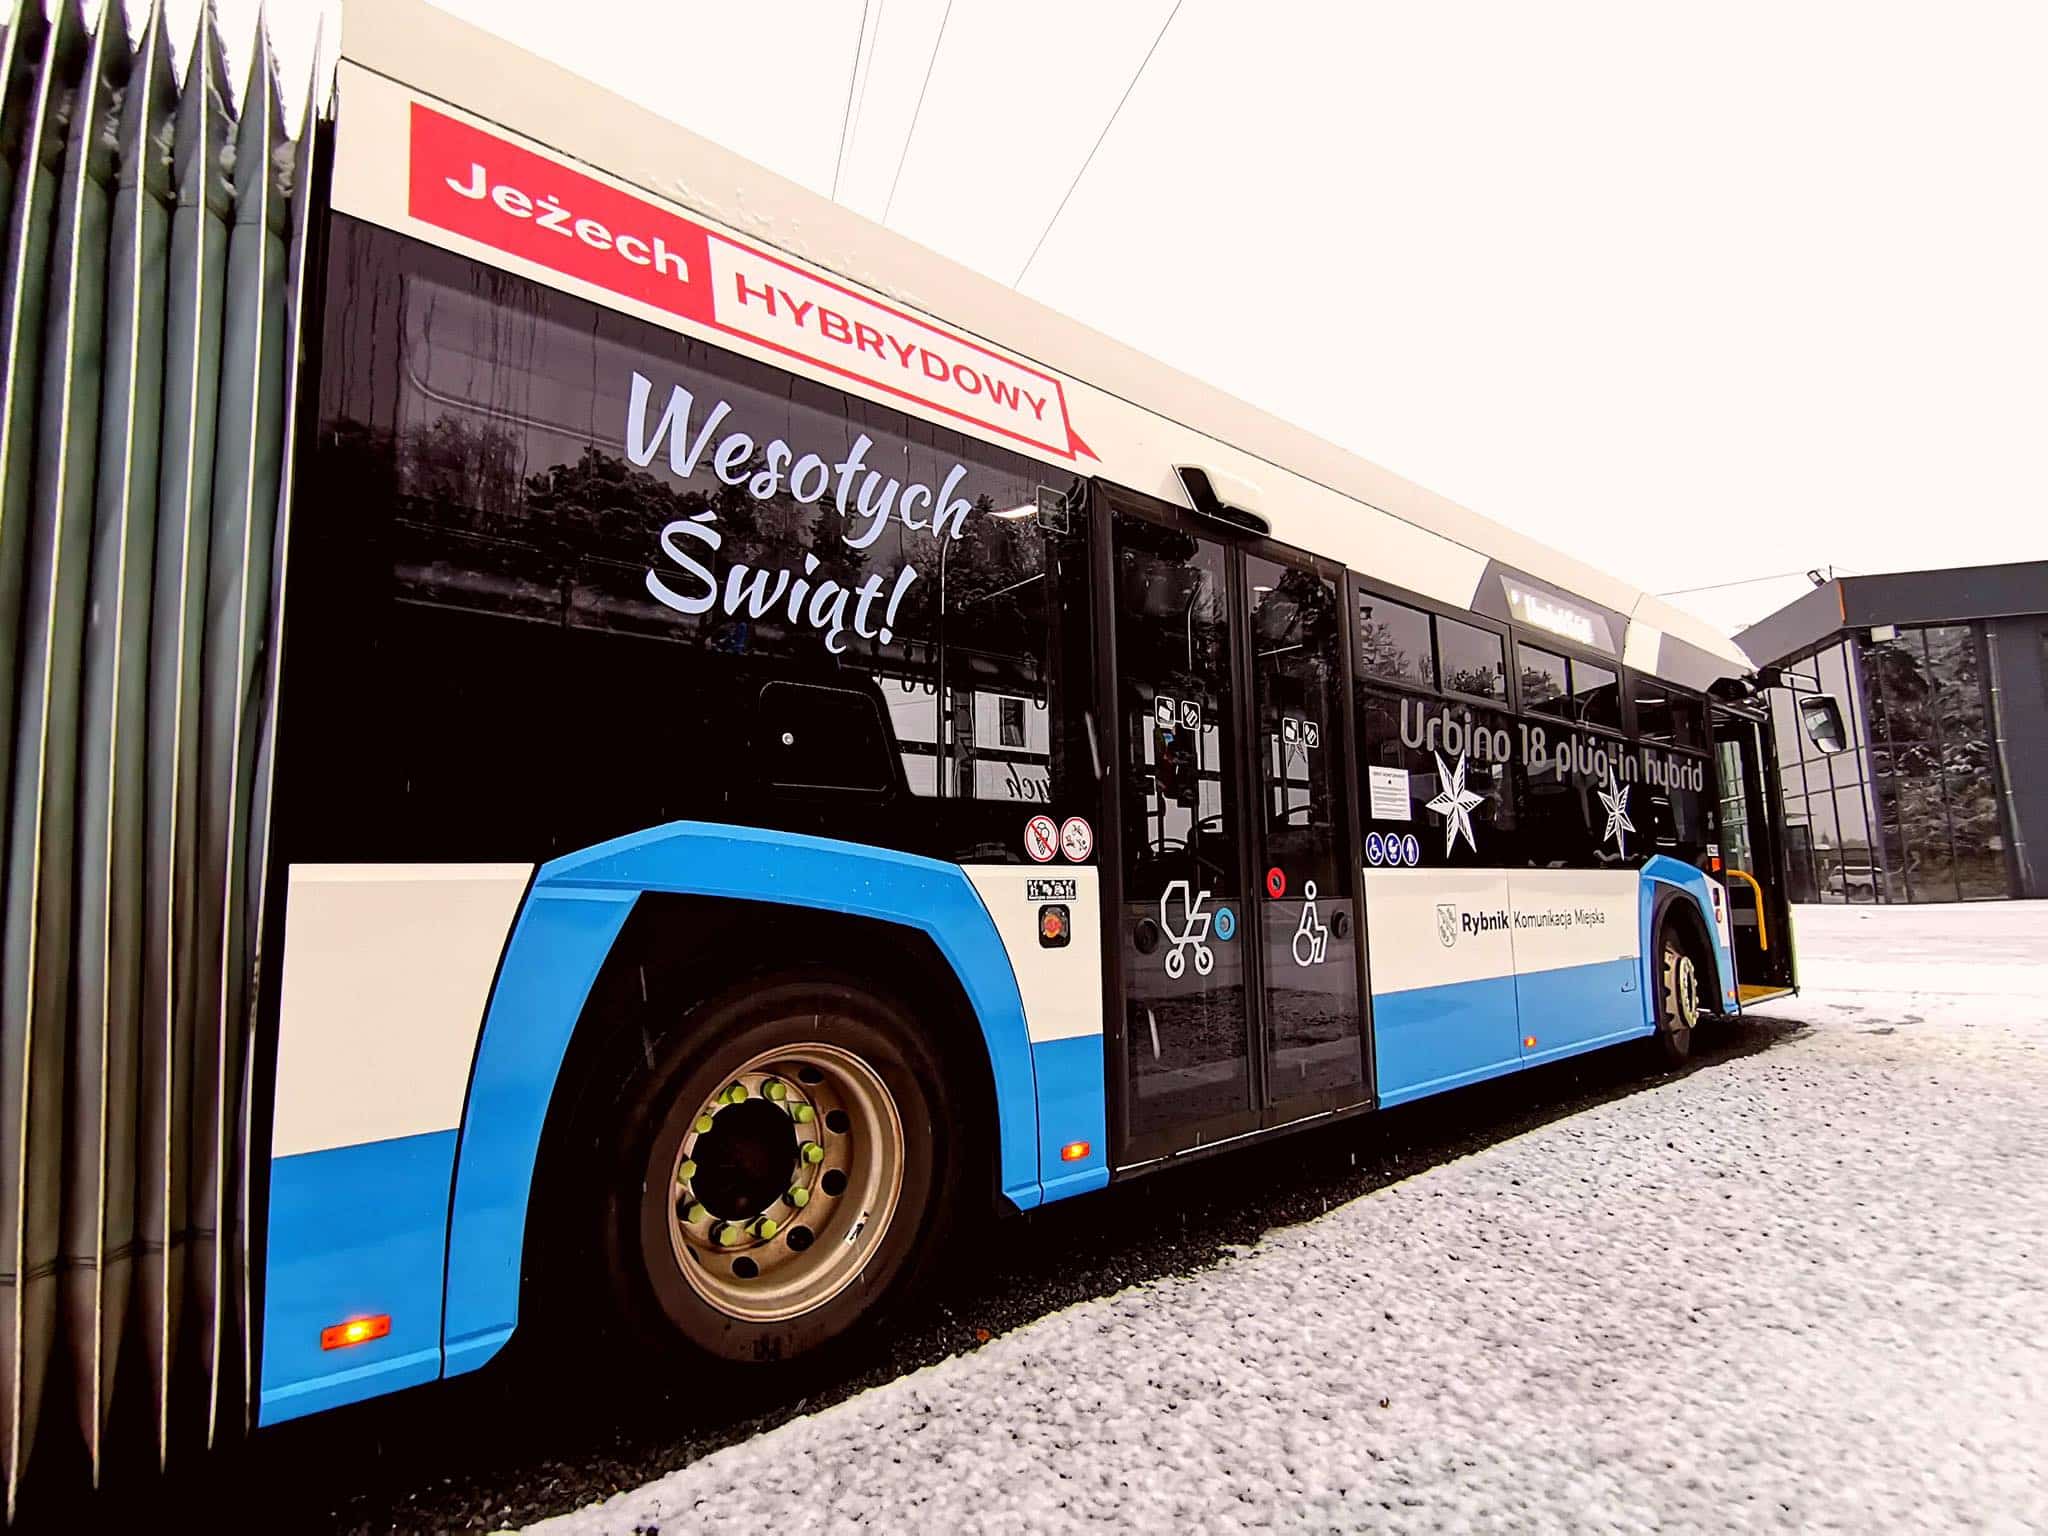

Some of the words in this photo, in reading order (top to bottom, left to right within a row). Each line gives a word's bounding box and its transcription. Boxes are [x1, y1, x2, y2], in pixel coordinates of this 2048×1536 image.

[445, 163, 690, 283] Jeżech
[735, 272, 1047, 421] HYBRYDOWY
[626, 371, 973, 550] Wesołych
[645, 510, 918, 654] Świąt!
[1400, 698, 1512, 763] Urbino
[1517, 722, 1547, 769] 18
[1645, 747, 1703, 796] hybrid
[1461, 910, 1510, 937] Rybnik
[1513, 909, 1573, 931] Komunikacja
[1574, 907, 1606, 929] Miejska
